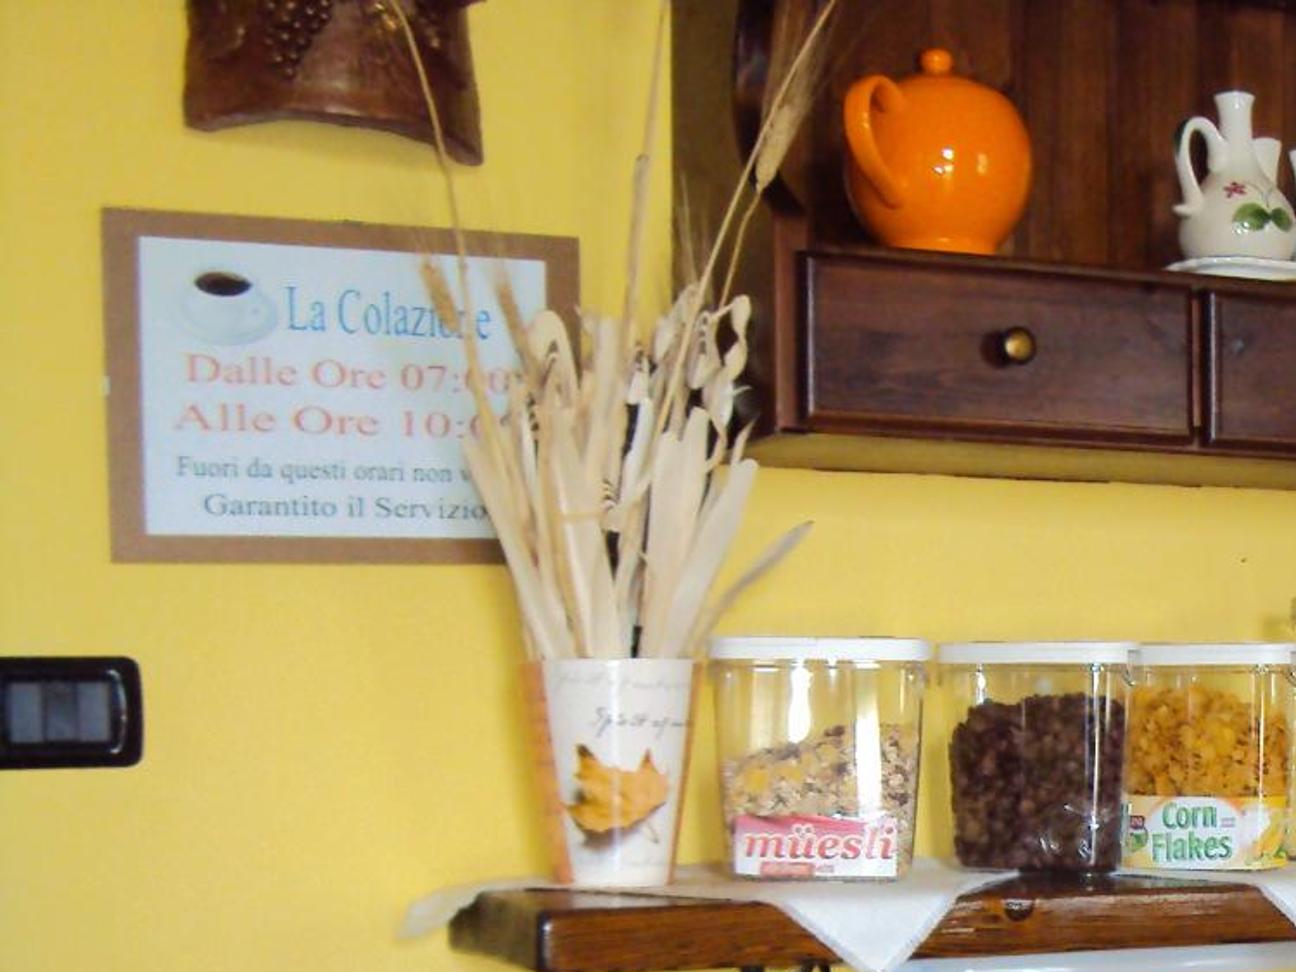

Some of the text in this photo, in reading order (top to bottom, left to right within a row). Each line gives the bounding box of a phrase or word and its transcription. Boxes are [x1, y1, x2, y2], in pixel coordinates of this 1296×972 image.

[287, 285, 326, 333] La
[184, 352, 298, 387] Dalle
[310, 358, 387, 390] Ore
[174, 402, 277, 434] Alle
[293, 405, 380, 437] Ore
[175, 456, 240, 479] Fuori
[247, 459, 273, 479] da
[281, 458, 346, 486] questi
[354, 462, 404, 482] orari
[413, 466, 454, 482] non
[204, 493, 488, 521] Garantito il Servizio
[1161, 801, 1218, 830] Corn
[743, 825, 895, 860] müesli
[1151, 831, 1233, 863] Flakes
